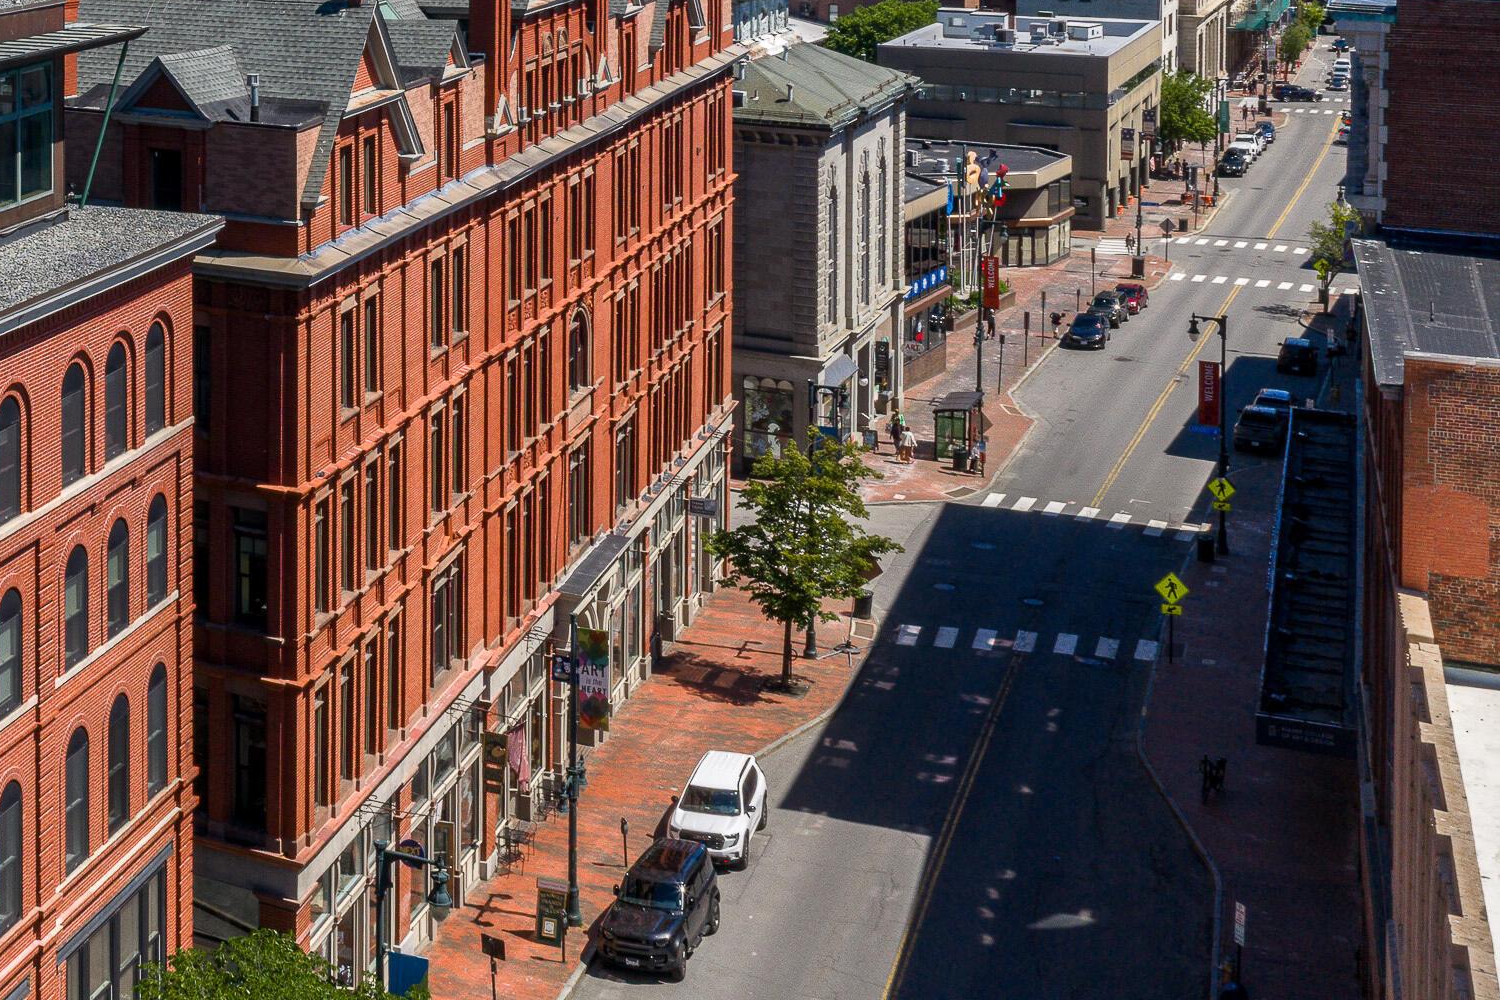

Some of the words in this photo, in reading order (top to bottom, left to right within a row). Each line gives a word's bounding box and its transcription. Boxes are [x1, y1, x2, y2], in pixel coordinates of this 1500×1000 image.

[1204, 362, 1213, 402] WELCOME
[581, 664, 605, 678] ART
[581, 685, 606, 695] HEART
